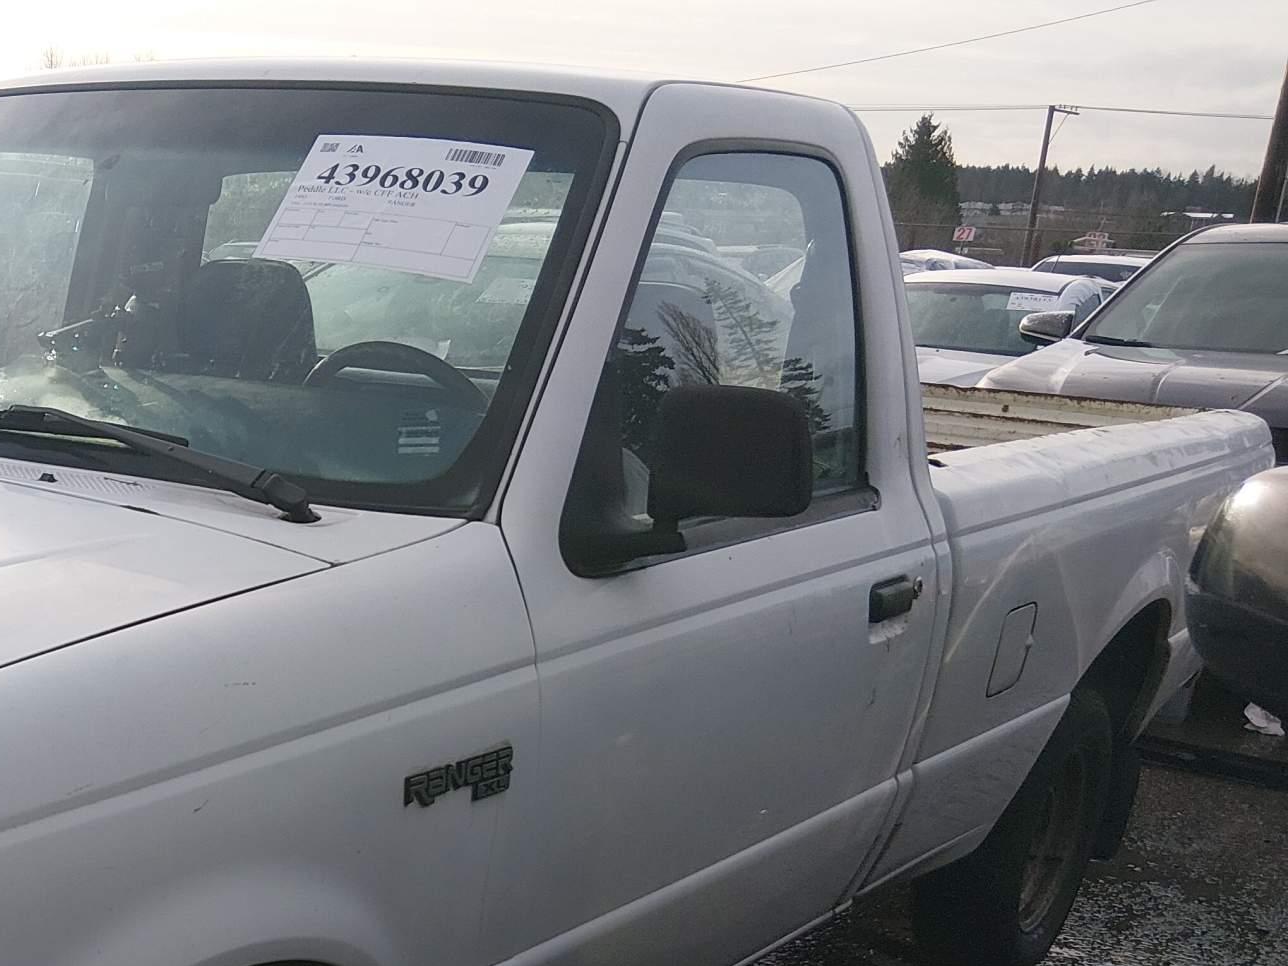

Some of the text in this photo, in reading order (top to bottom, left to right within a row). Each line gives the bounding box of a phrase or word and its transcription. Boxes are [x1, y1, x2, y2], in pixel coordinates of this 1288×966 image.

[297, 184, 326, 193] Peddle
[328, 185, 348, 194] LLC
[316, 163, 489, 197] 43968039
[956, 227, 973, 240] 27
[404, 746, 514, 808] RANGER
